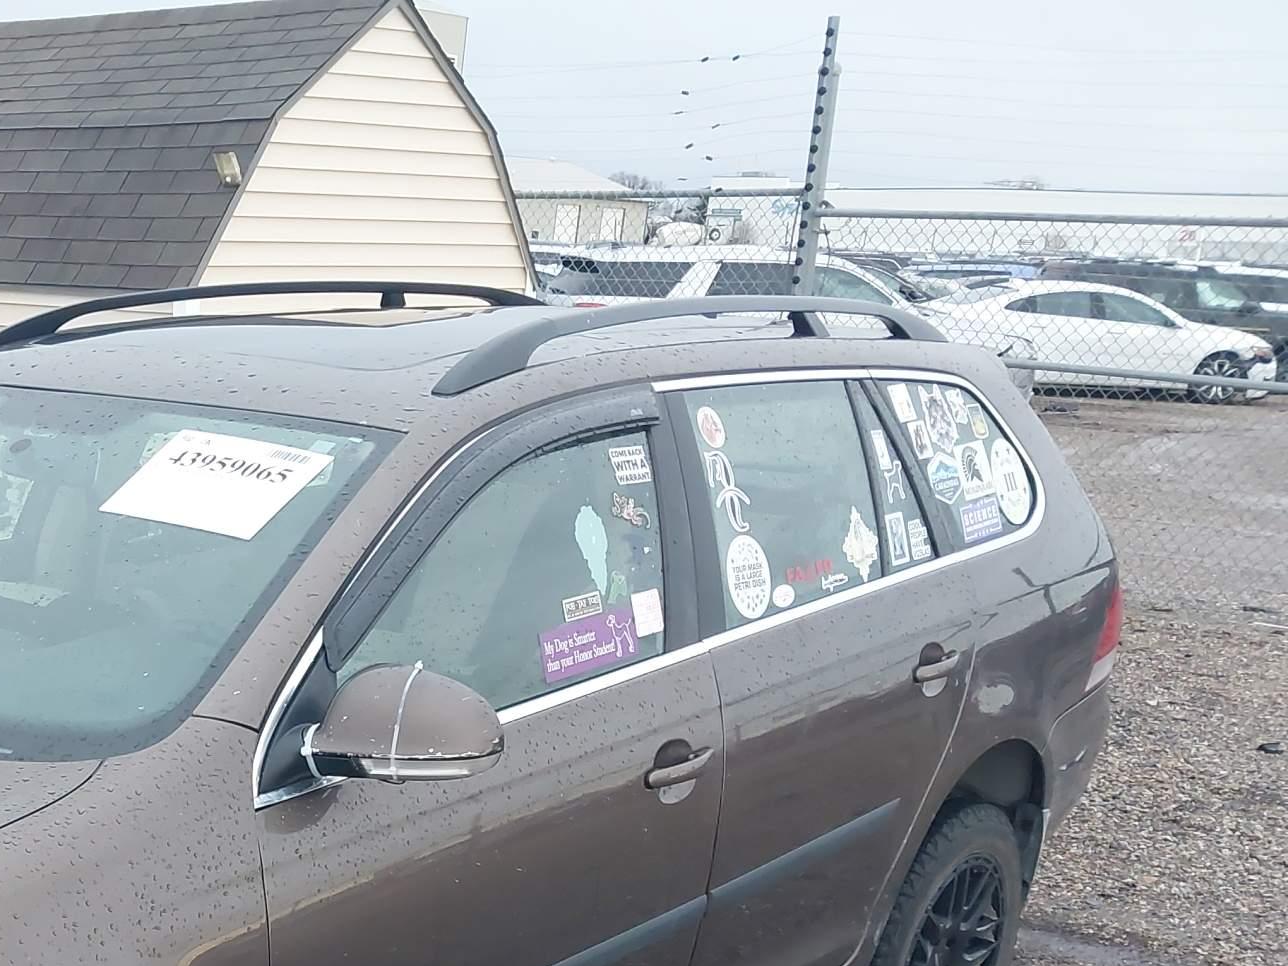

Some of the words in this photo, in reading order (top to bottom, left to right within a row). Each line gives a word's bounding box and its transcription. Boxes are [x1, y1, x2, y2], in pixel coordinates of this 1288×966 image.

[169, 450, 294, 483] 43959065
[614, 460, 639, 472] WITH
[640, 458, 648, 469] A
[618, 472, 651, 483] WARRANT
[964, 505, 998, 526] SCIENCE
[732, 564, 747, 574] YOUR
[748, 562, 762, 571] MASK
[734, 580, 751, 591] PETRI
[752, 577, 766, 588] DISH
[544, 640, 555, 658] My
[554, 638, 570, 654] Dog
[574, 631, 596, 646] Smarter
[547, 658, 560, 673] than
[560, 656, 574, 673] your
[574, 649, 592, 664] Honor
